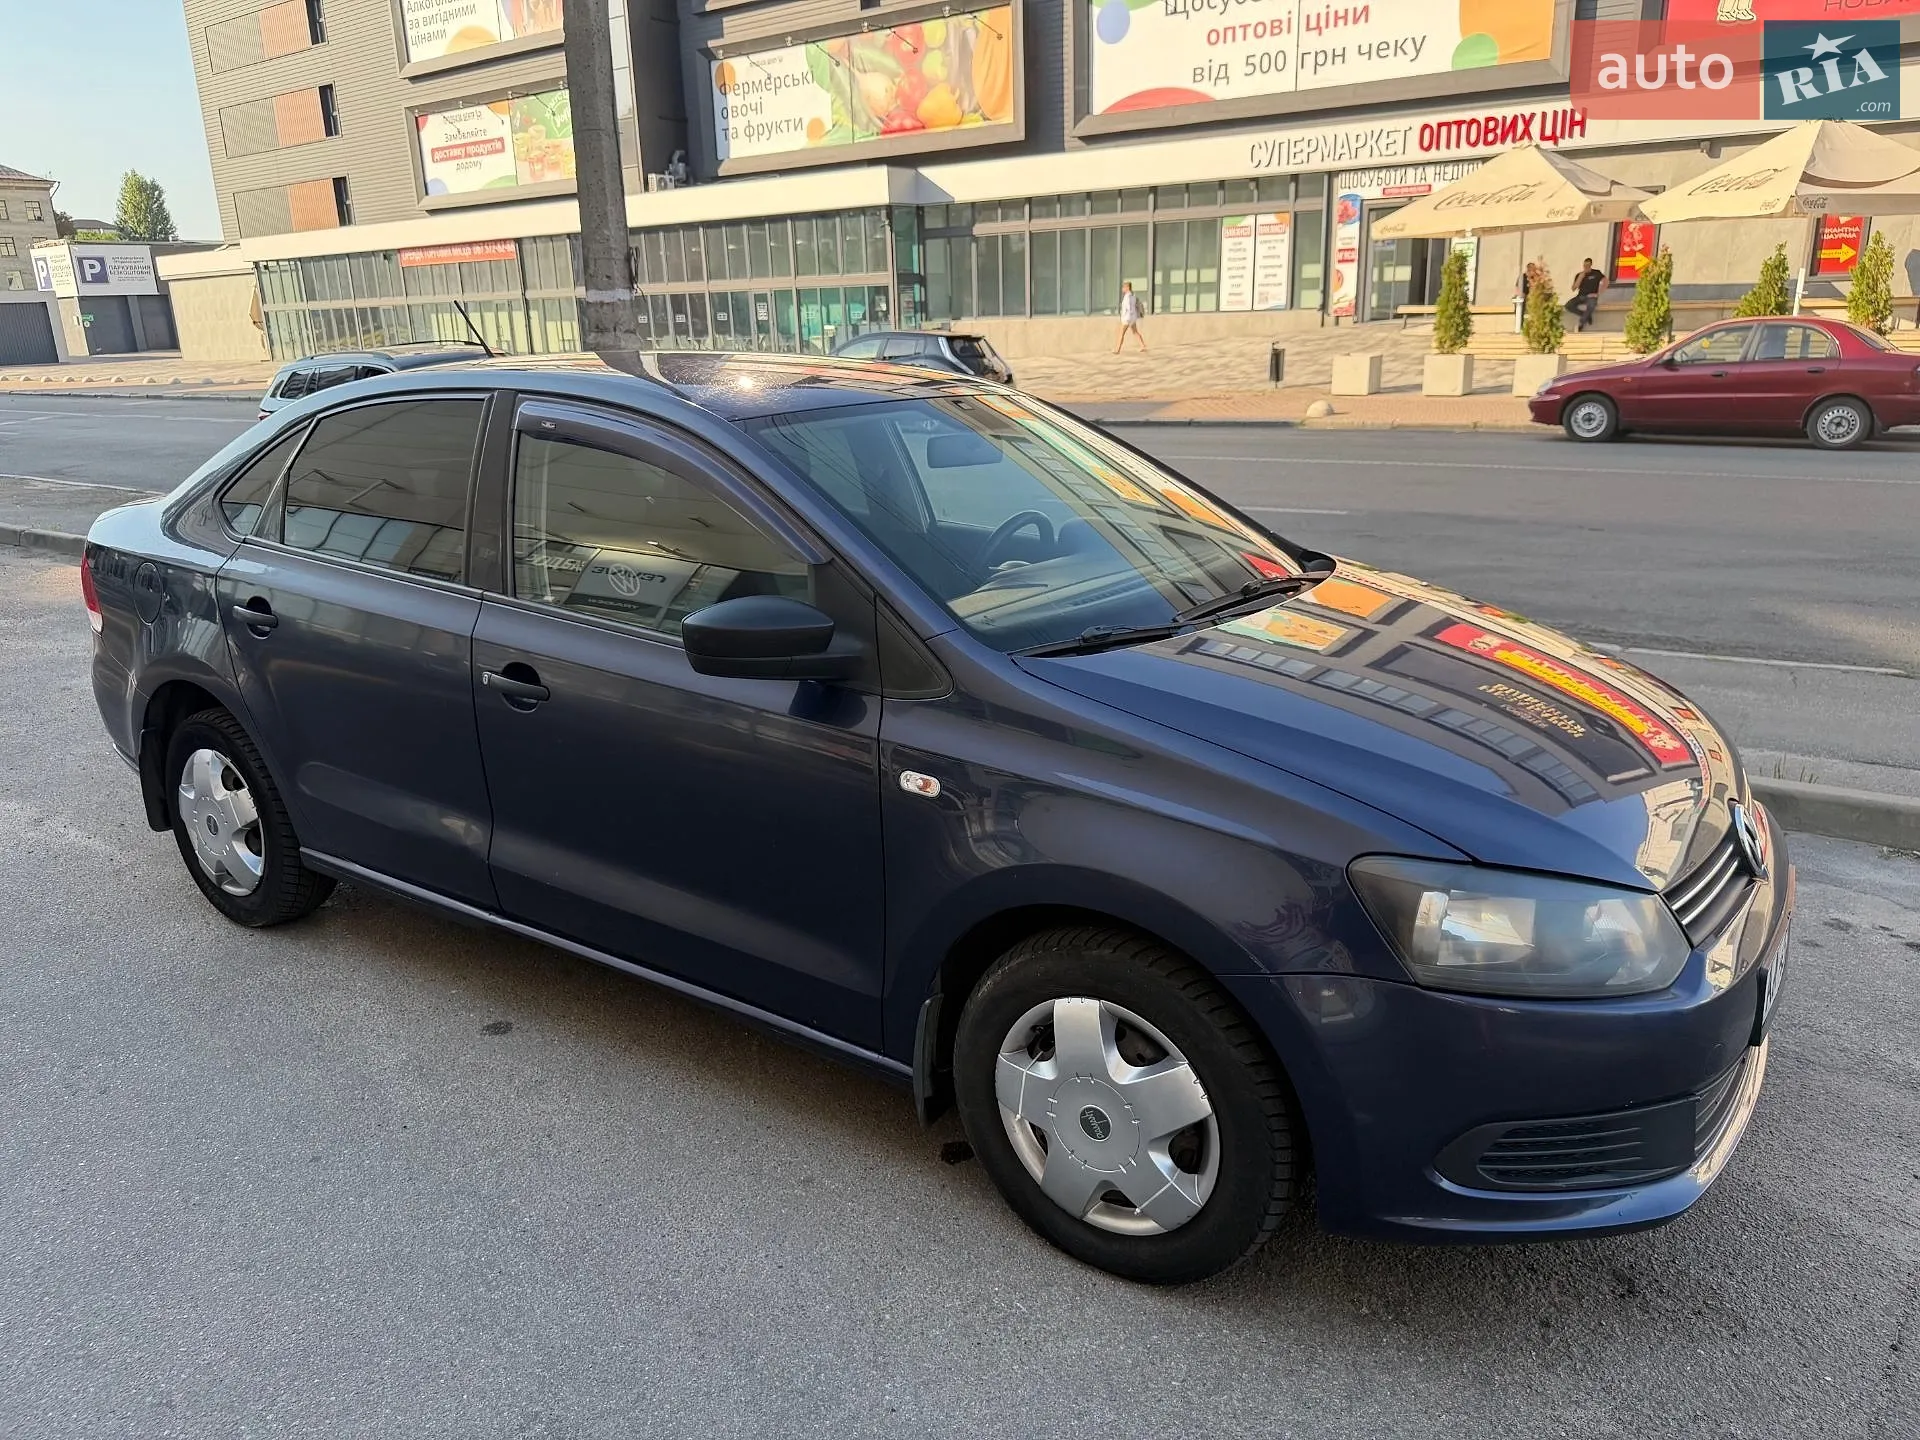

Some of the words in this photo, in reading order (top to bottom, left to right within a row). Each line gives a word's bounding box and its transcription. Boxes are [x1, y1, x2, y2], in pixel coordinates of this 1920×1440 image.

[409, 19, 420, 30] за
[422, 4, 477, 27] вигідними
[1206, 10, 1293, 47] оптові
[1305, 4, 1371, 37] ціни
[410, 28, 447, 48] цінами
[1192, 59, 1230, 86] від
[1244, 50, 1287, 77] 500
[1300, 46, 1346, 75] грн
[1357, 34, 1427, 63] чеку
[721, 97, 763, 120] овочі
[444, 128, 488, 143] Замовляйте
[722, 126, 739, 141] та
[743, 117, 804, 143] фрукти
[1250, 125, 1412, 168] СУПЕРМАРКЕТ
[1418, 112, 1536, 152] ОПТОВИХ
[1540, 106, 1588, 146] ЦІН
[433, 147, 465, 163] доставку
[467, 138, 503, 158] продуктів
[456, 160, 483, 173] додому
[1339, 169, 1407, 190] ЩОСУБОТИ
[1414, 167, 1428, 182] ТА
